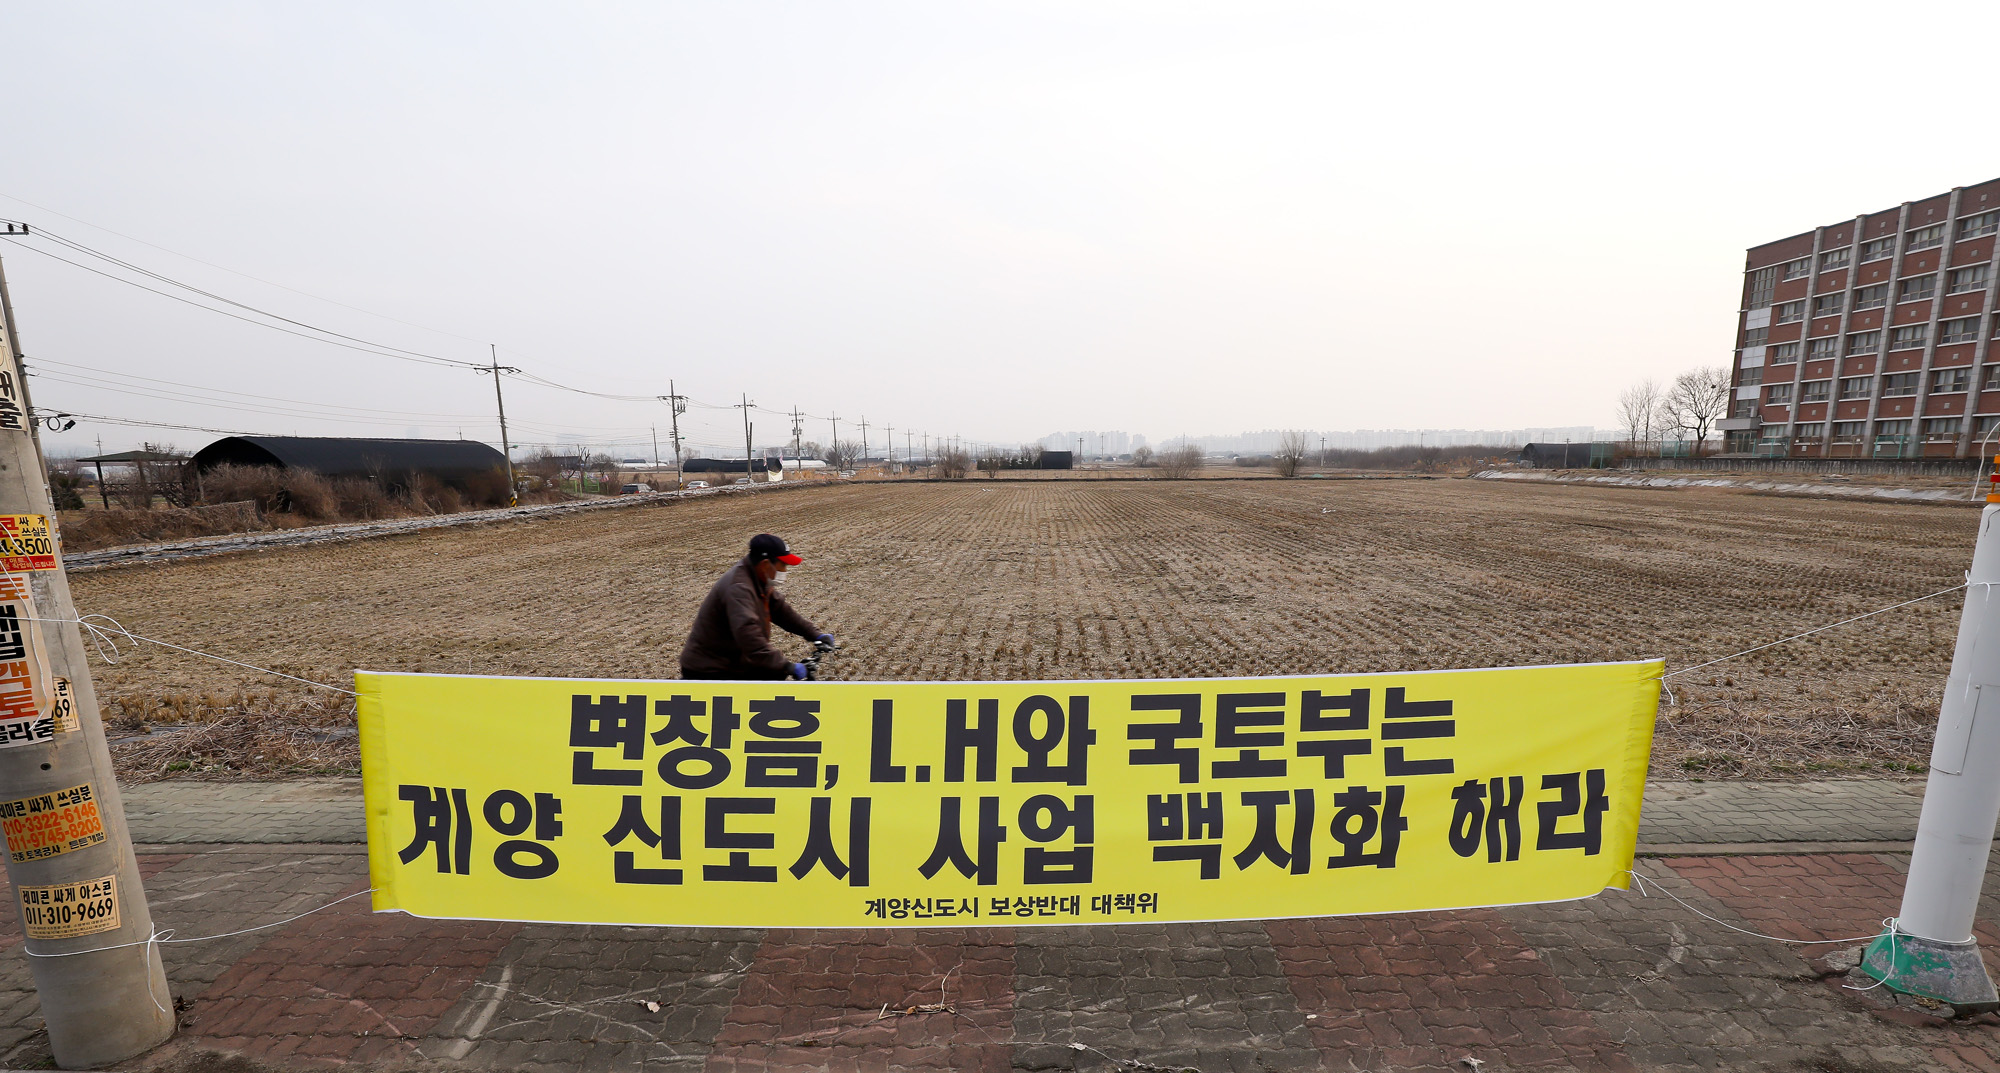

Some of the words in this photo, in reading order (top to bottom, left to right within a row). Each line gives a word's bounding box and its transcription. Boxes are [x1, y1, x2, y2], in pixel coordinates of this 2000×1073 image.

[52, 699, 70, 718] 69
[569, 695, 838, 790] 변창흠,
[1127, 687, 1455, 784] 국토부는
[28, 795, 54, 813] 싸게
[57, 785, 92, 808] 쓰실분
[3, 802, 96, 836] 010-3322-6146
[398, 785, 562, 879] 계양
[603, 795, 871, 886] 신도시
[918, 795, 1094, 885] 사업
[1148, 785, 1408, 879] 백지화
[1448, 769, 1609, 863] 해라
[8, 817, 101, 852] 011-9745-8203
[22, 890, 50, 905] 레미콘
[53, 887, 76, 904] 싸게
[79, 880, 112, 899] 아스콘
[865, 897, 978, 918] 계양신도시
[989, 895, 1080, 917] 보상반대
[1092, 893, 1157, 914] 대책위
[25, 897, 113, 925] 011-310-9669
